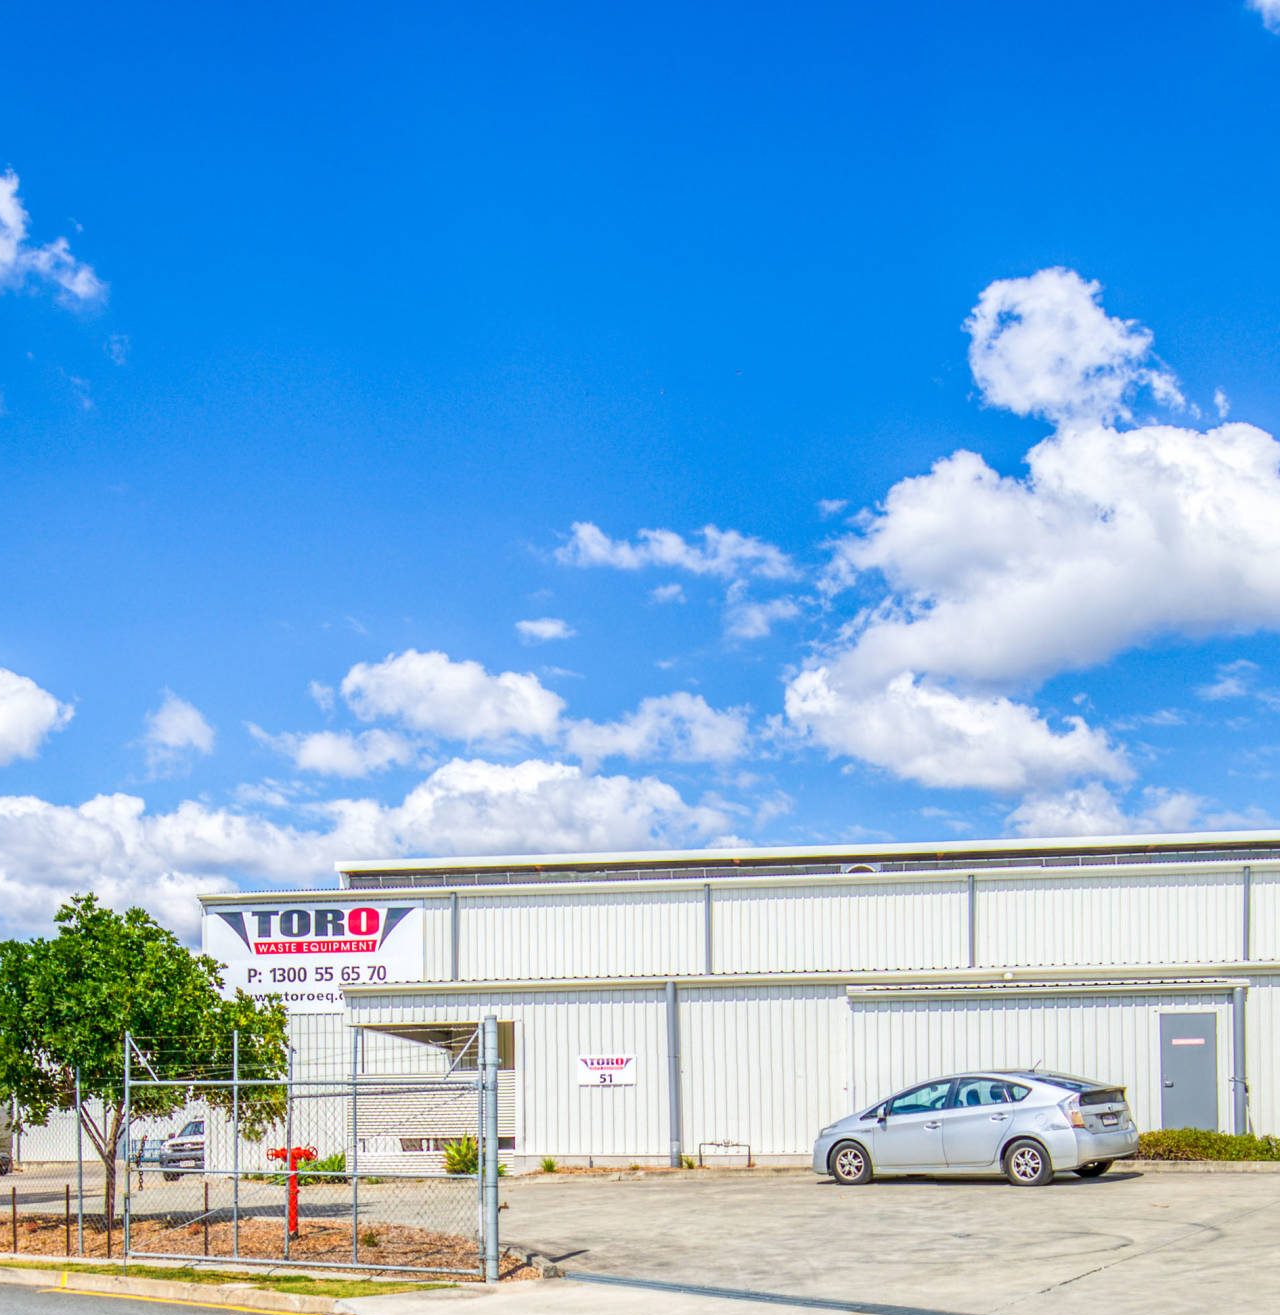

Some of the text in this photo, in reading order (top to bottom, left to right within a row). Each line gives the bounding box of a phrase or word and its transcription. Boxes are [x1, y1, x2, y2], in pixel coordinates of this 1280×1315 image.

[251, 907, 380, 937] TORO
[258, 941, 374, 953] WASTE EQUIPMENT
[247, 965, 387, 983] P: 1300 55 65 70
[589, 1058, 624, 1066] TORO
[600, 1074, 613, 1083] 51
